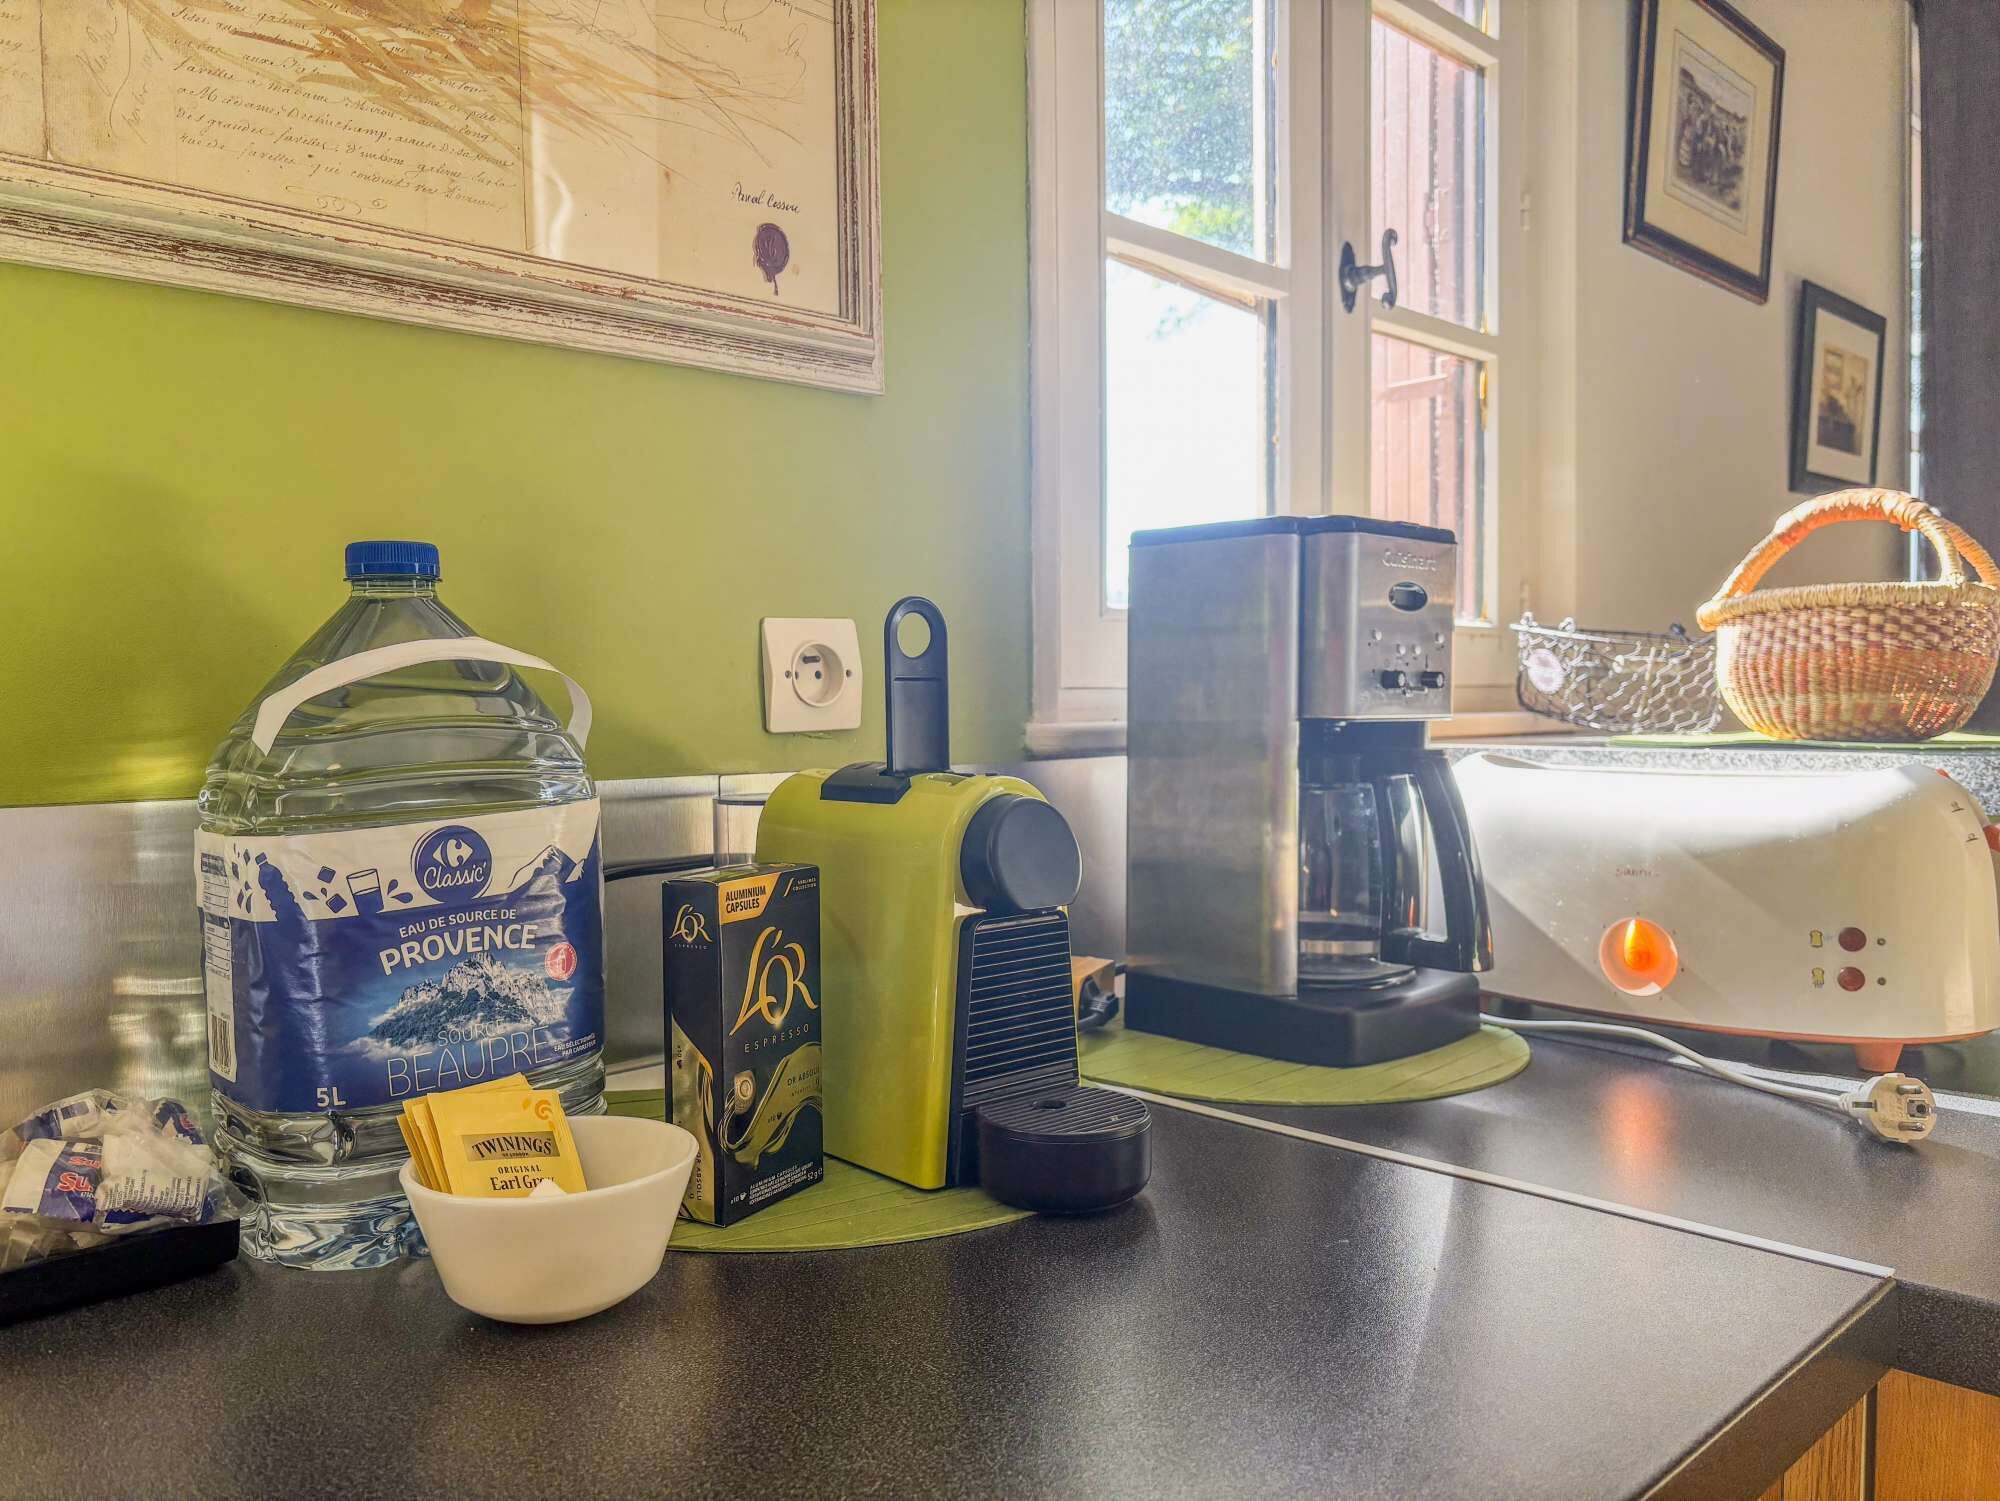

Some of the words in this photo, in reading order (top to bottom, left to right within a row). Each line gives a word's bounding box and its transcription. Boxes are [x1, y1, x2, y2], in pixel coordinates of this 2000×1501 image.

[725, 885, 767, 903] ALUMINIUM
[725, 897, 760, 914] CAPSULES
[399, 919, 425, 938] EAU
[428, 917, 446, 934] DE
[449, 910, 498, 931] SOURCE
[500, 908, 517, 922] DE
[378, 923, 540, 977] PROVENCE
[437, 1017, 505, 1047] SOURCE
[743, 1023, 811, 1054] ESPRESSO
[316, 1087, 347, 1109] 5L
[471, 1135, 552, 1159] TWININGS
[498, 1163, 542, 1175] ORIGINAL
[490, 1175, 522, 1192] Earl
[522, 1174, 555, 1189] Gr
